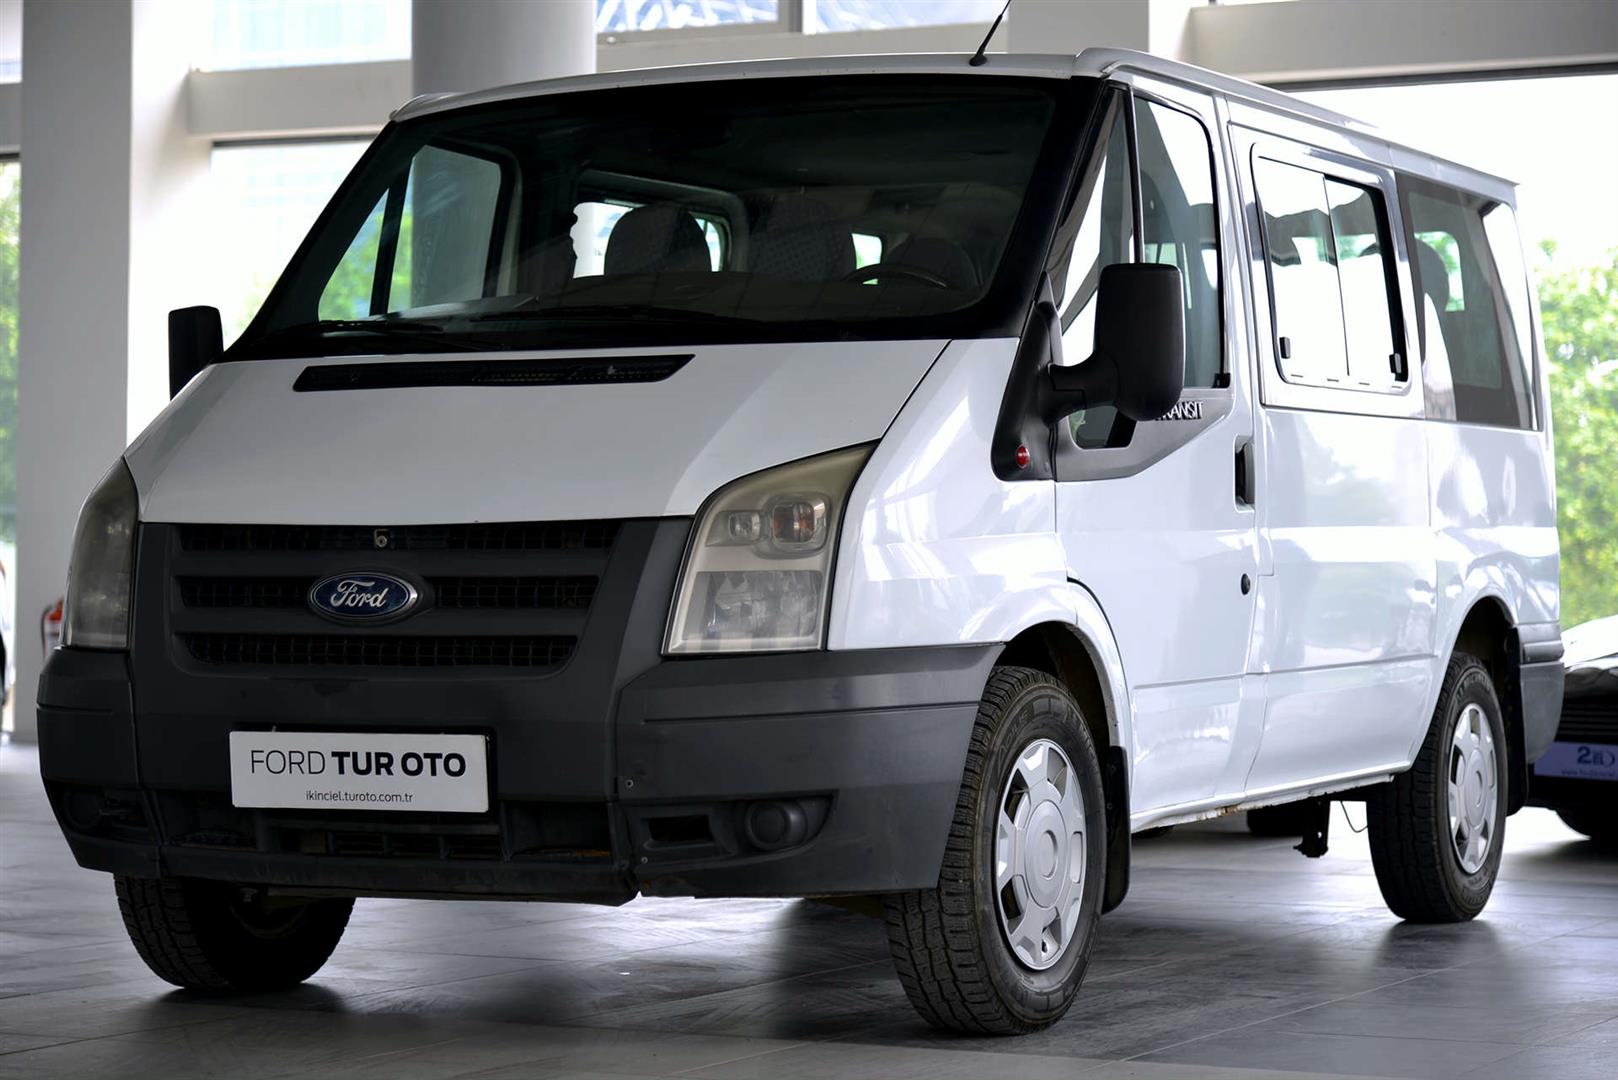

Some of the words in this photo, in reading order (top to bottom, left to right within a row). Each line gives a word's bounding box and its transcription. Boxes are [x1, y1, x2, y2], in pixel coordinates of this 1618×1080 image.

[1157, 401, 1203, 420] ANSIT
[330, 579, 390, 608] Ford
[250, 750, 326, 775] FORD
[331, 751, 394, 776] TUR
[401, 752, 467, 778] OTO
[306, 790, 414, 803] ikinciel.turoto.com.tr
